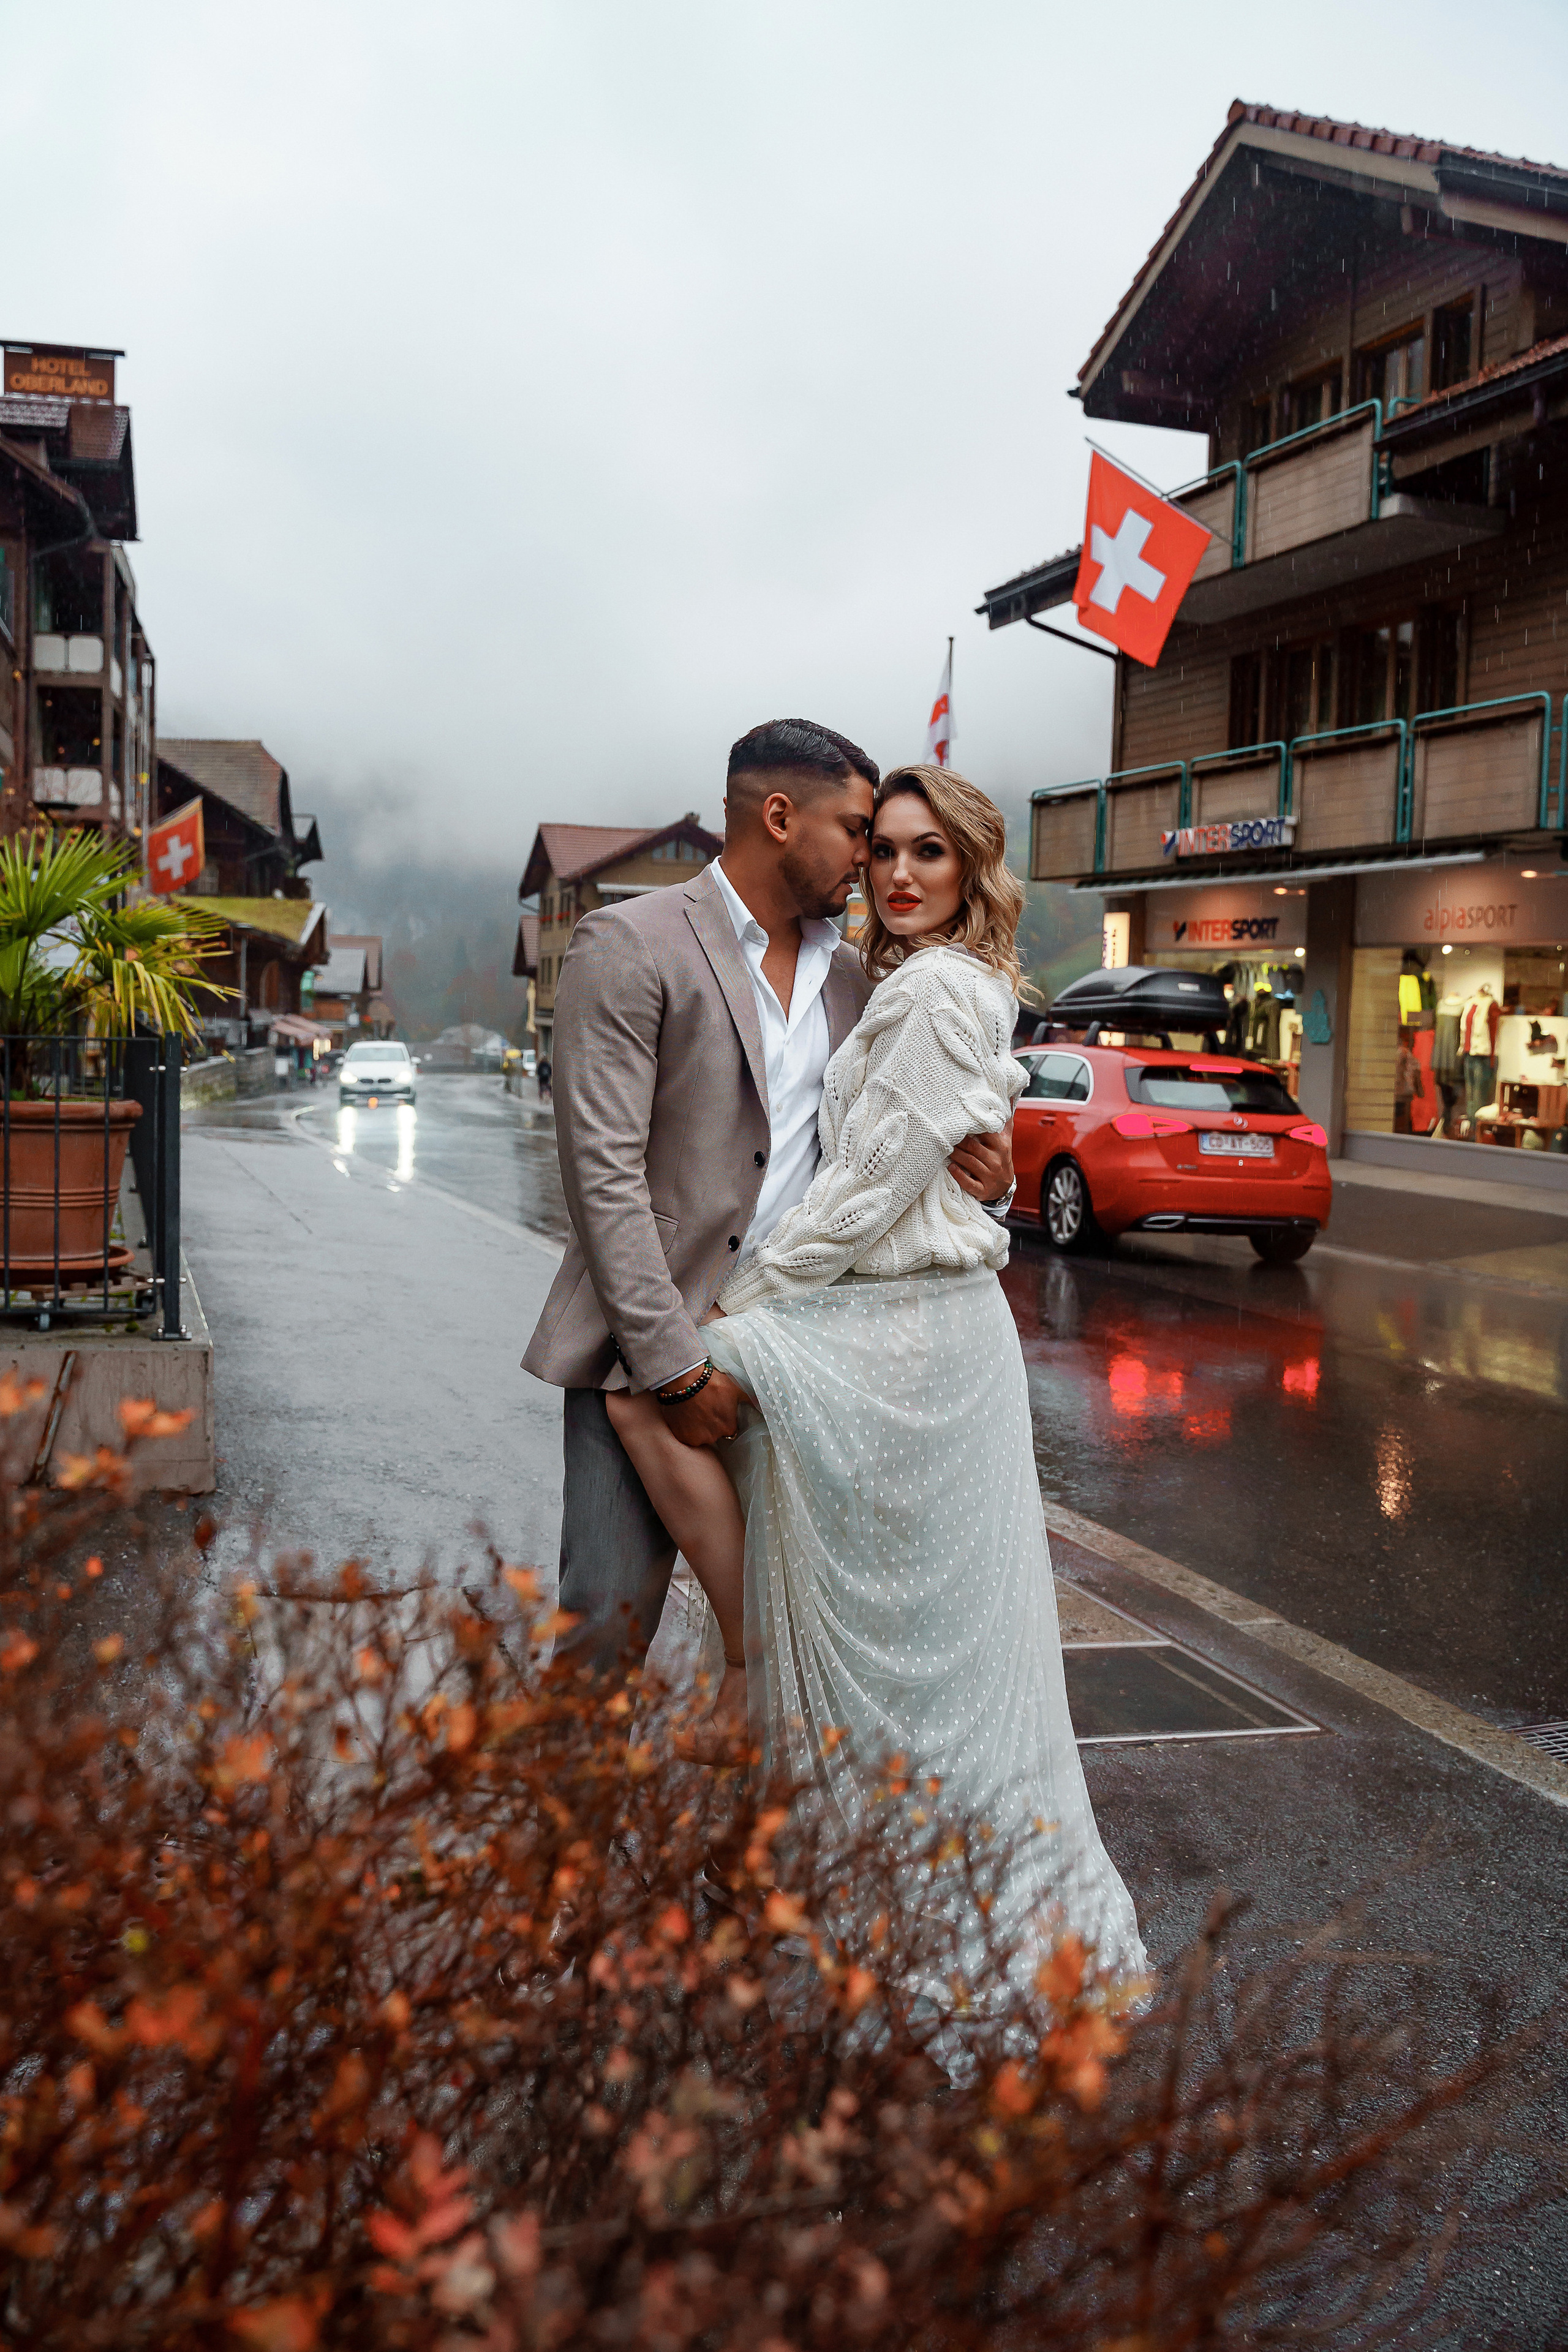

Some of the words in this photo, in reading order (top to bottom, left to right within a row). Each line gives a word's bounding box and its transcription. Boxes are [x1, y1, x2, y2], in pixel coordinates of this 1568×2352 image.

[31, 357, 91, 377] HOTEL
[1178, 818, 1285, 856] INTERSPORT
[1188, 918, 1279, 942] INTERSPORT
